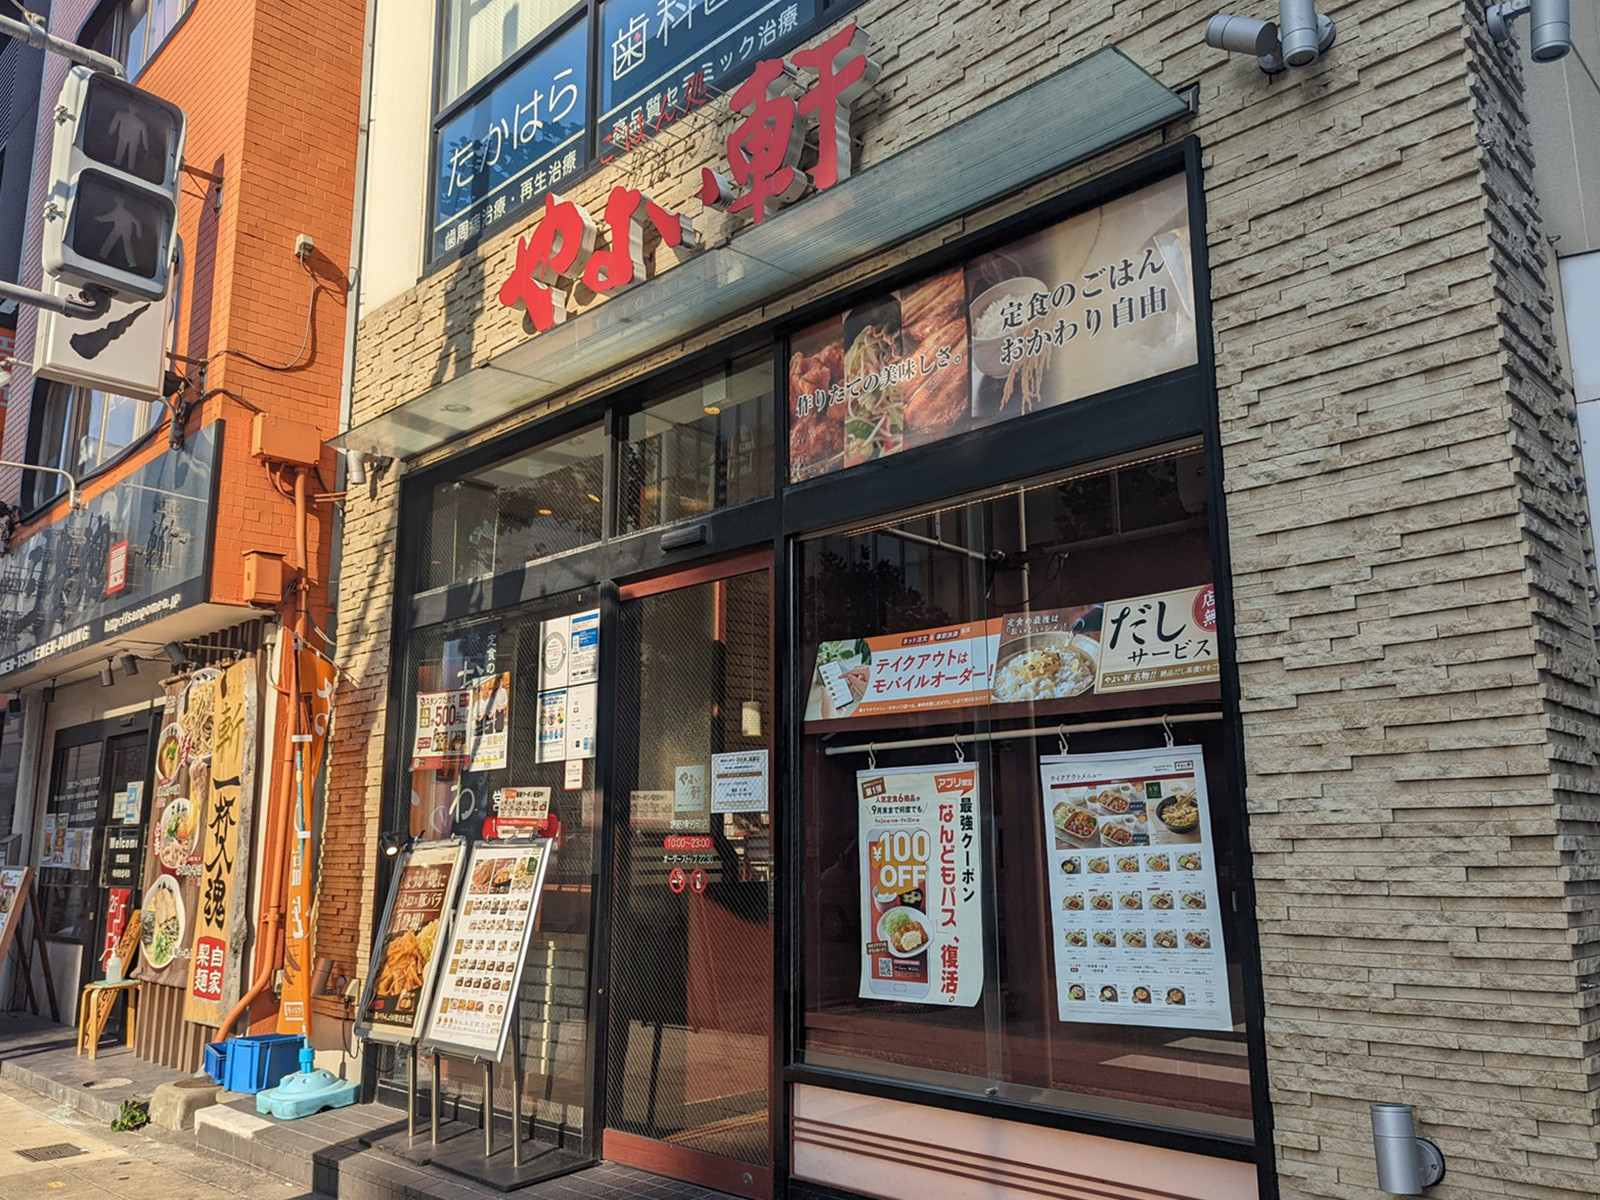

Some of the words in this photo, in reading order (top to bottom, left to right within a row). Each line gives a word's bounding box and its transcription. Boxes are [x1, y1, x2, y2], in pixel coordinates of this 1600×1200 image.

[612, 0, 728, 81] 歯科
[447, 69, 578, 197] たかはら
[444, 150, 577, 251] 歯周病治療・再生治療
[499, 23, 868, 332] やよい軒
[999, 248, 1165, 333] 定食のごはん
[1000, 285, 1168, 366] おかわり自由
[796, 346, 964, 419] 作りたての美味しさ。
[1006, 615, 1059, 628] 定食の最後は
[1109, 601, 1187, 650] だし
[876, 649, 969, 675] テイクアウトは
[1127, 639, 1211, 667] サービス
[873, 664, 995, 694] モバイルオーダー!
[1050, 773, 1103, 783] テイクアウトメニュー
[960, 798, 975, 903] 最強クーポン
[402, 868, 447, 890] ょうが焼に
[880, 865, 927, 888] OFF
[208, 946, 224, 995] 自家
